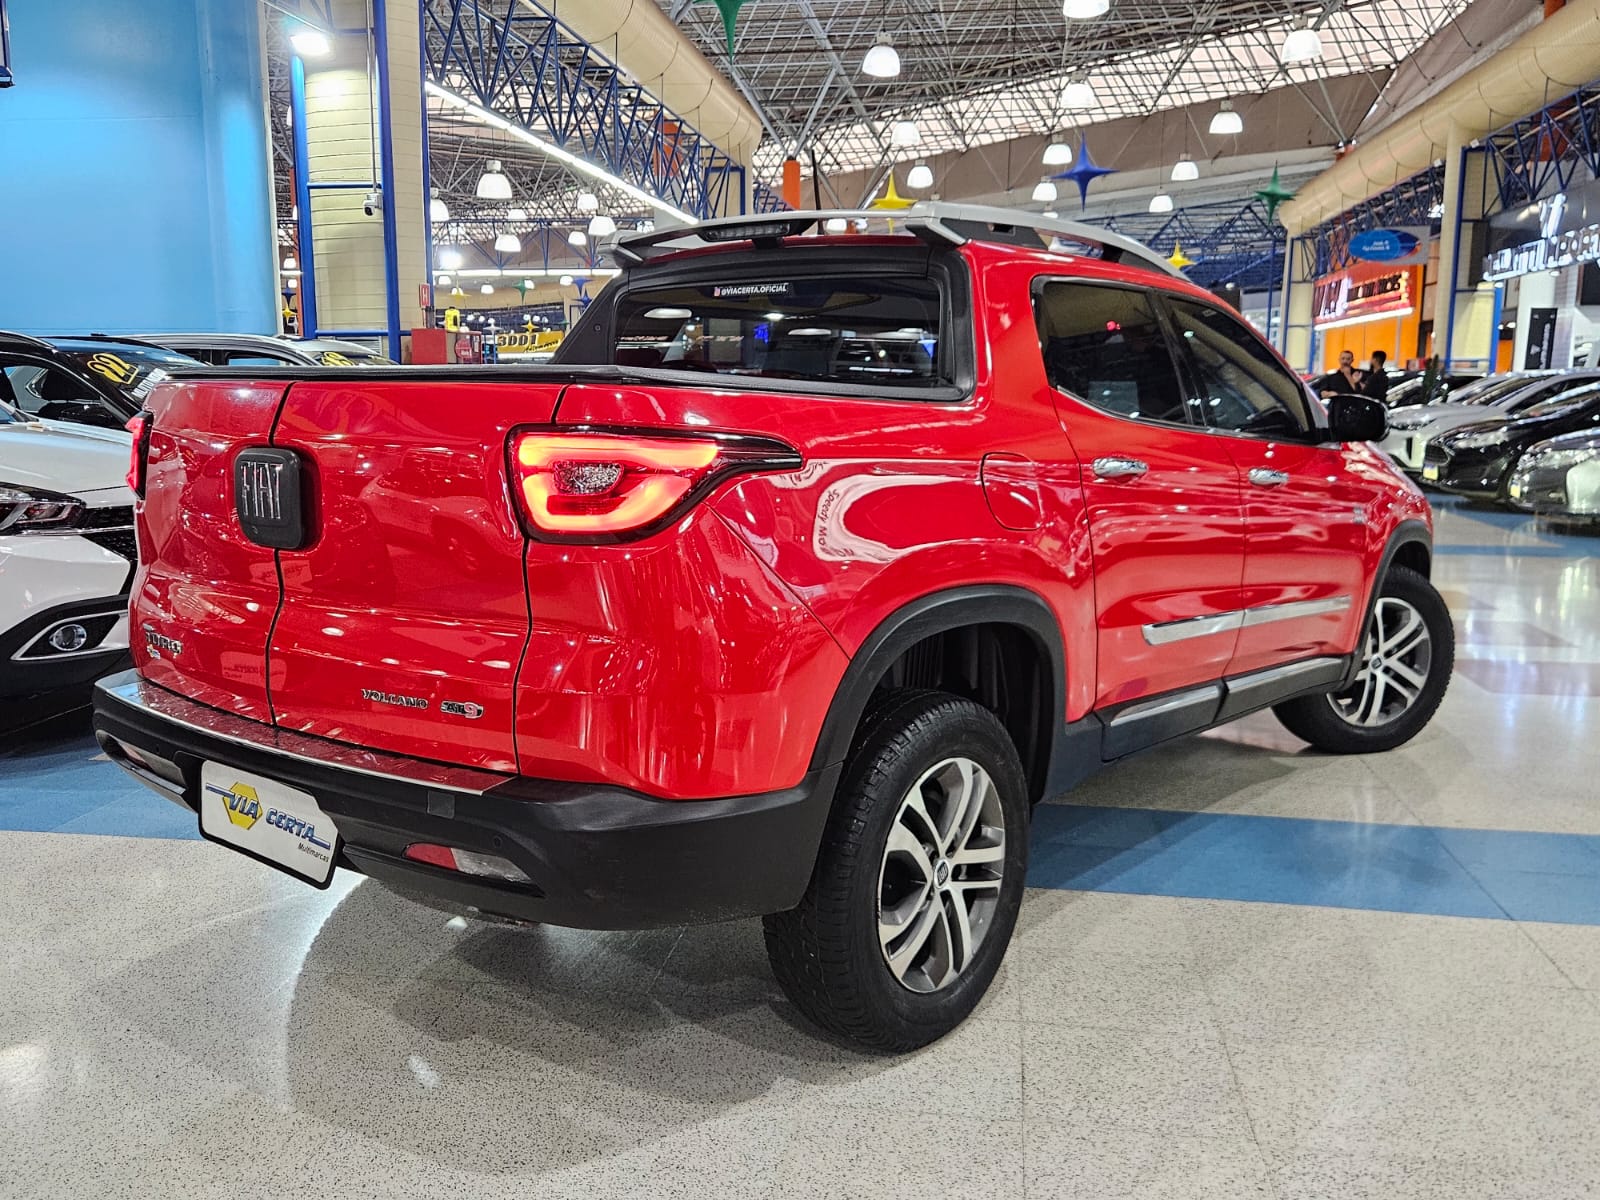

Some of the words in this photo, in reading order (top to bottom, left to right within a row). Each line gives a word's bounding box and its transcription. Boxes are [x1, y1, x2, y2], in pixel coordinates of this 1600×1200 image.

[721, 283, 789, 296] @VIACERTA.OFICIAL
[240, 461, 283, 519] FIAT
[817, 488, 840, 523] Speedy
[361, 688, 428, 710] VOLCANO
[228, 793, 260, 820] VIA
[266, 807, 316, 840] CERTA
[298, 842, 329, 863] Multimarcas
